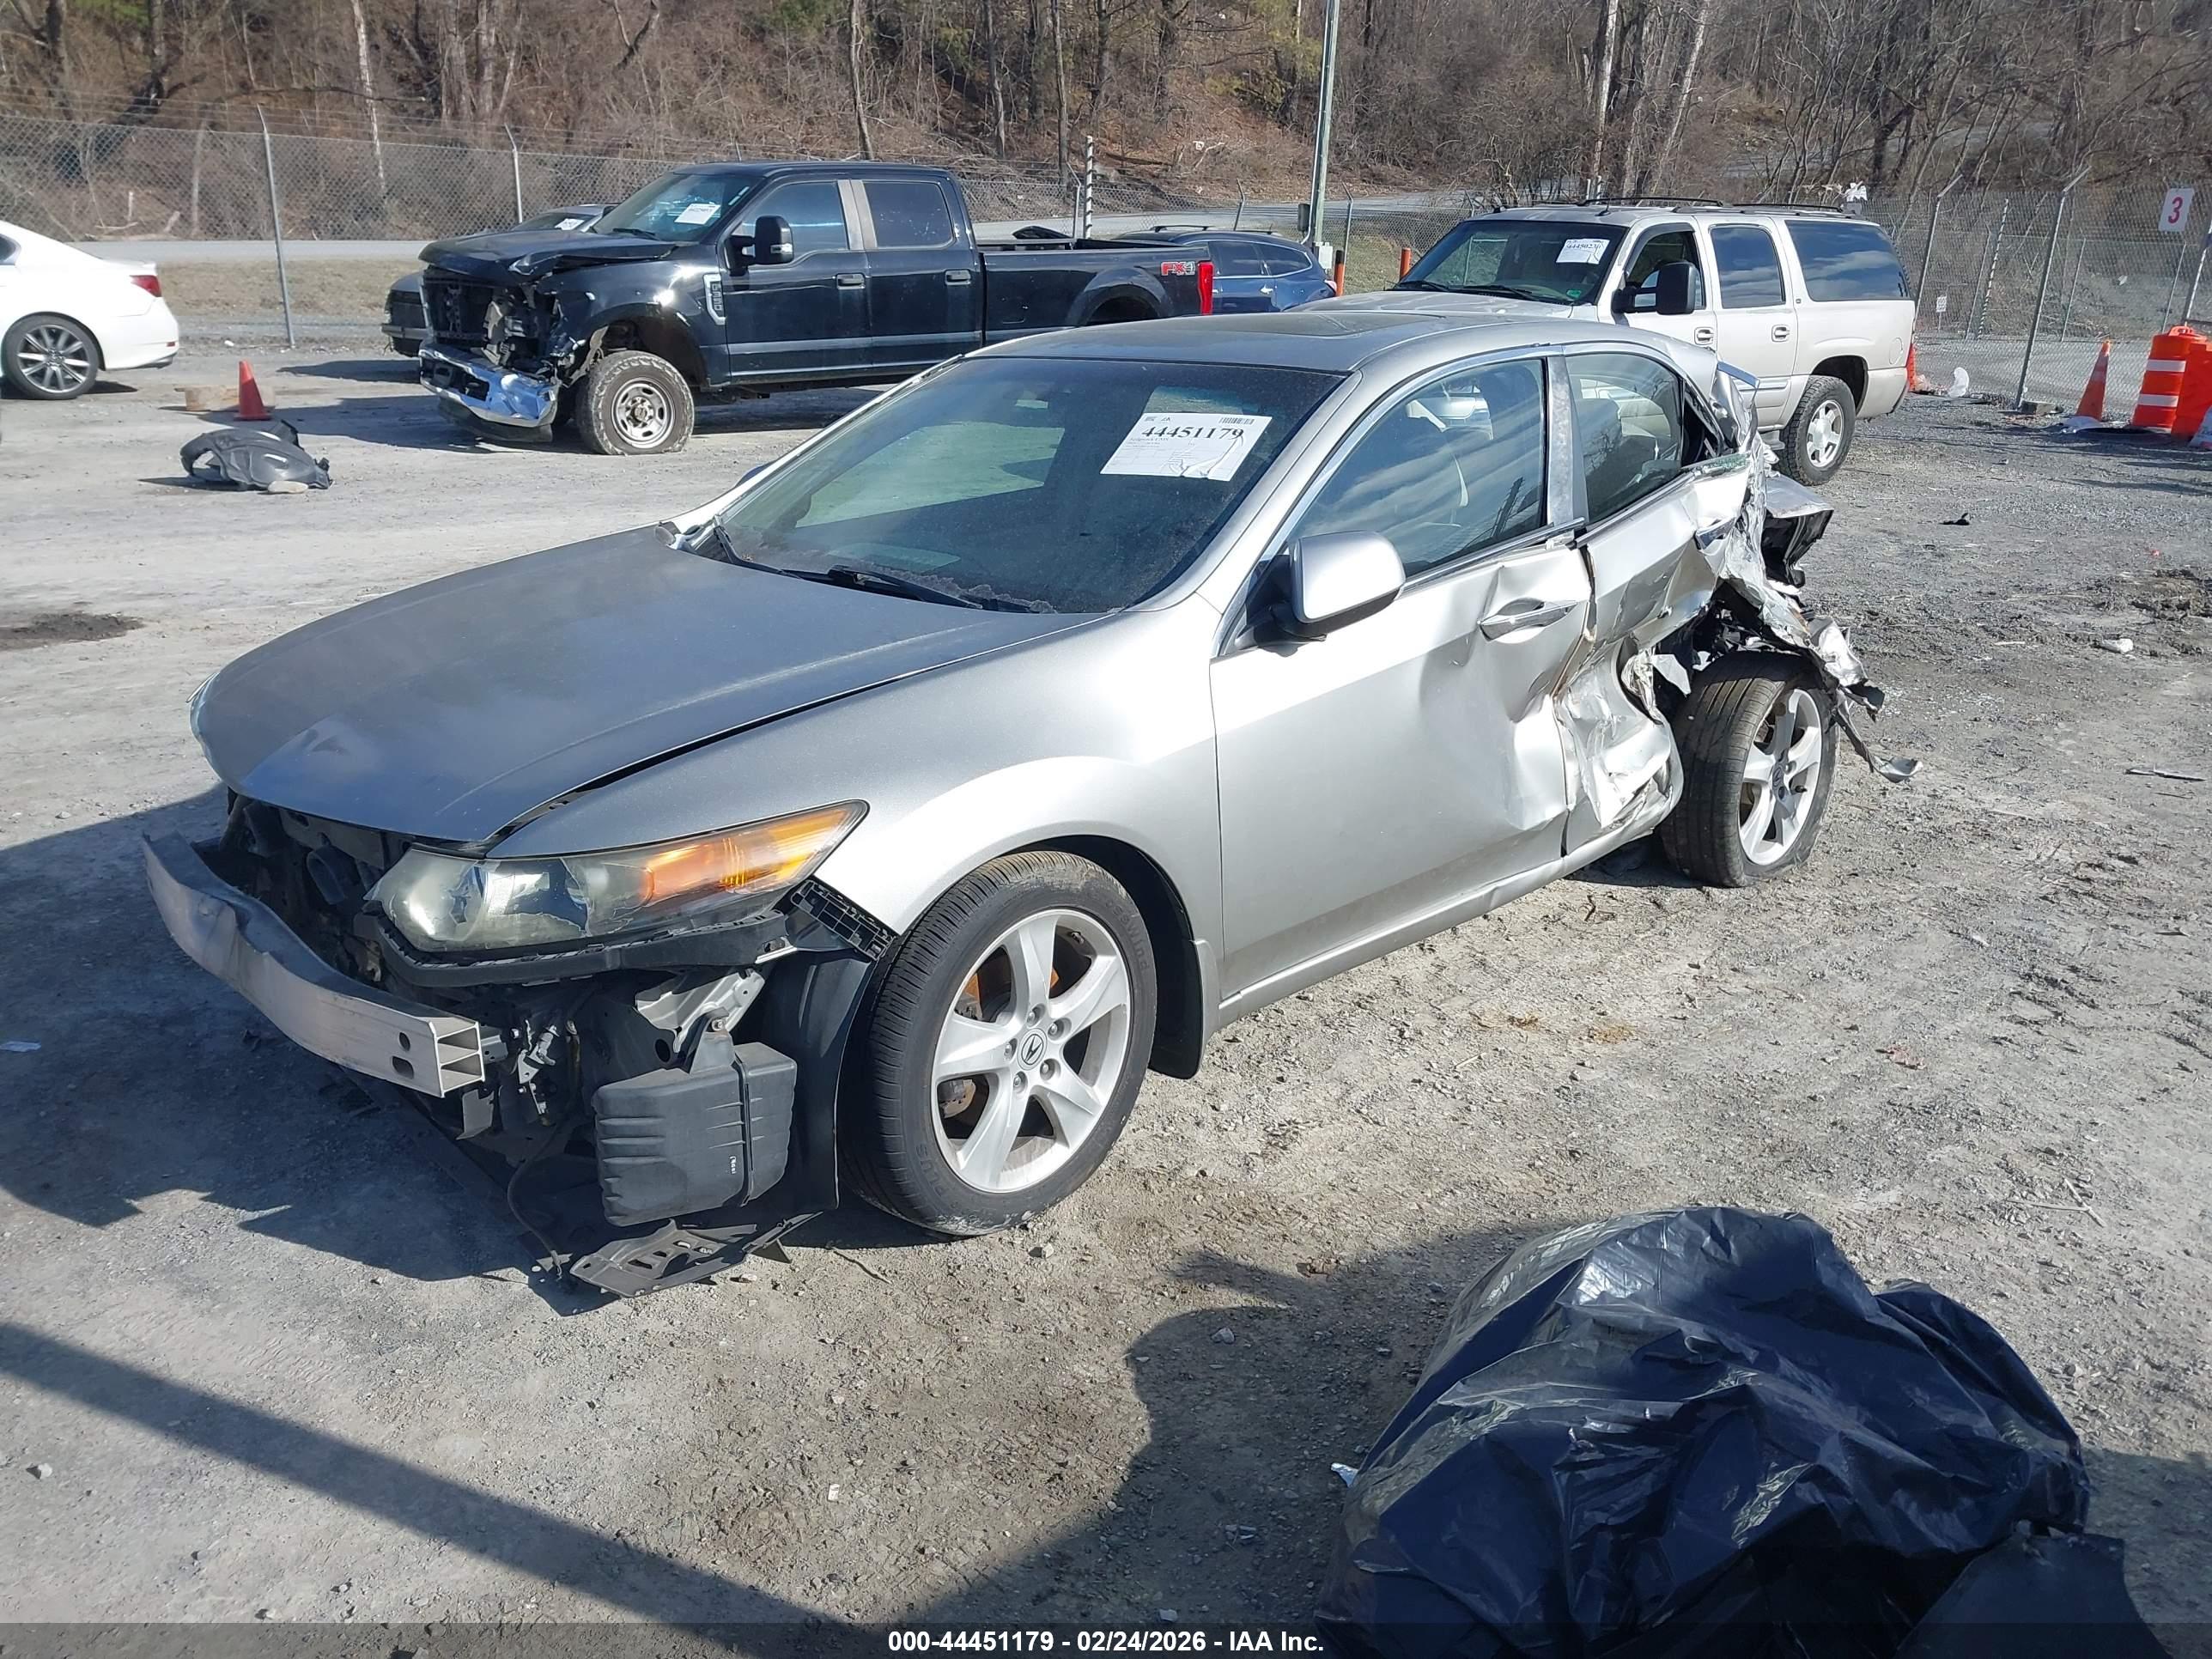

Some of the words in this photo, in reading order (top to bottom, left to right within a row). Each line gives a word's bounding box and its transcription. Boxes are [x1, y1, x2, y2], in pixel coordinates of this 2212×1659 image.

[2168, 197, 2184, 224] 3
[1160, 261, 1196, 276] FX4
[1141, 426, 1244, 441] 44451179
